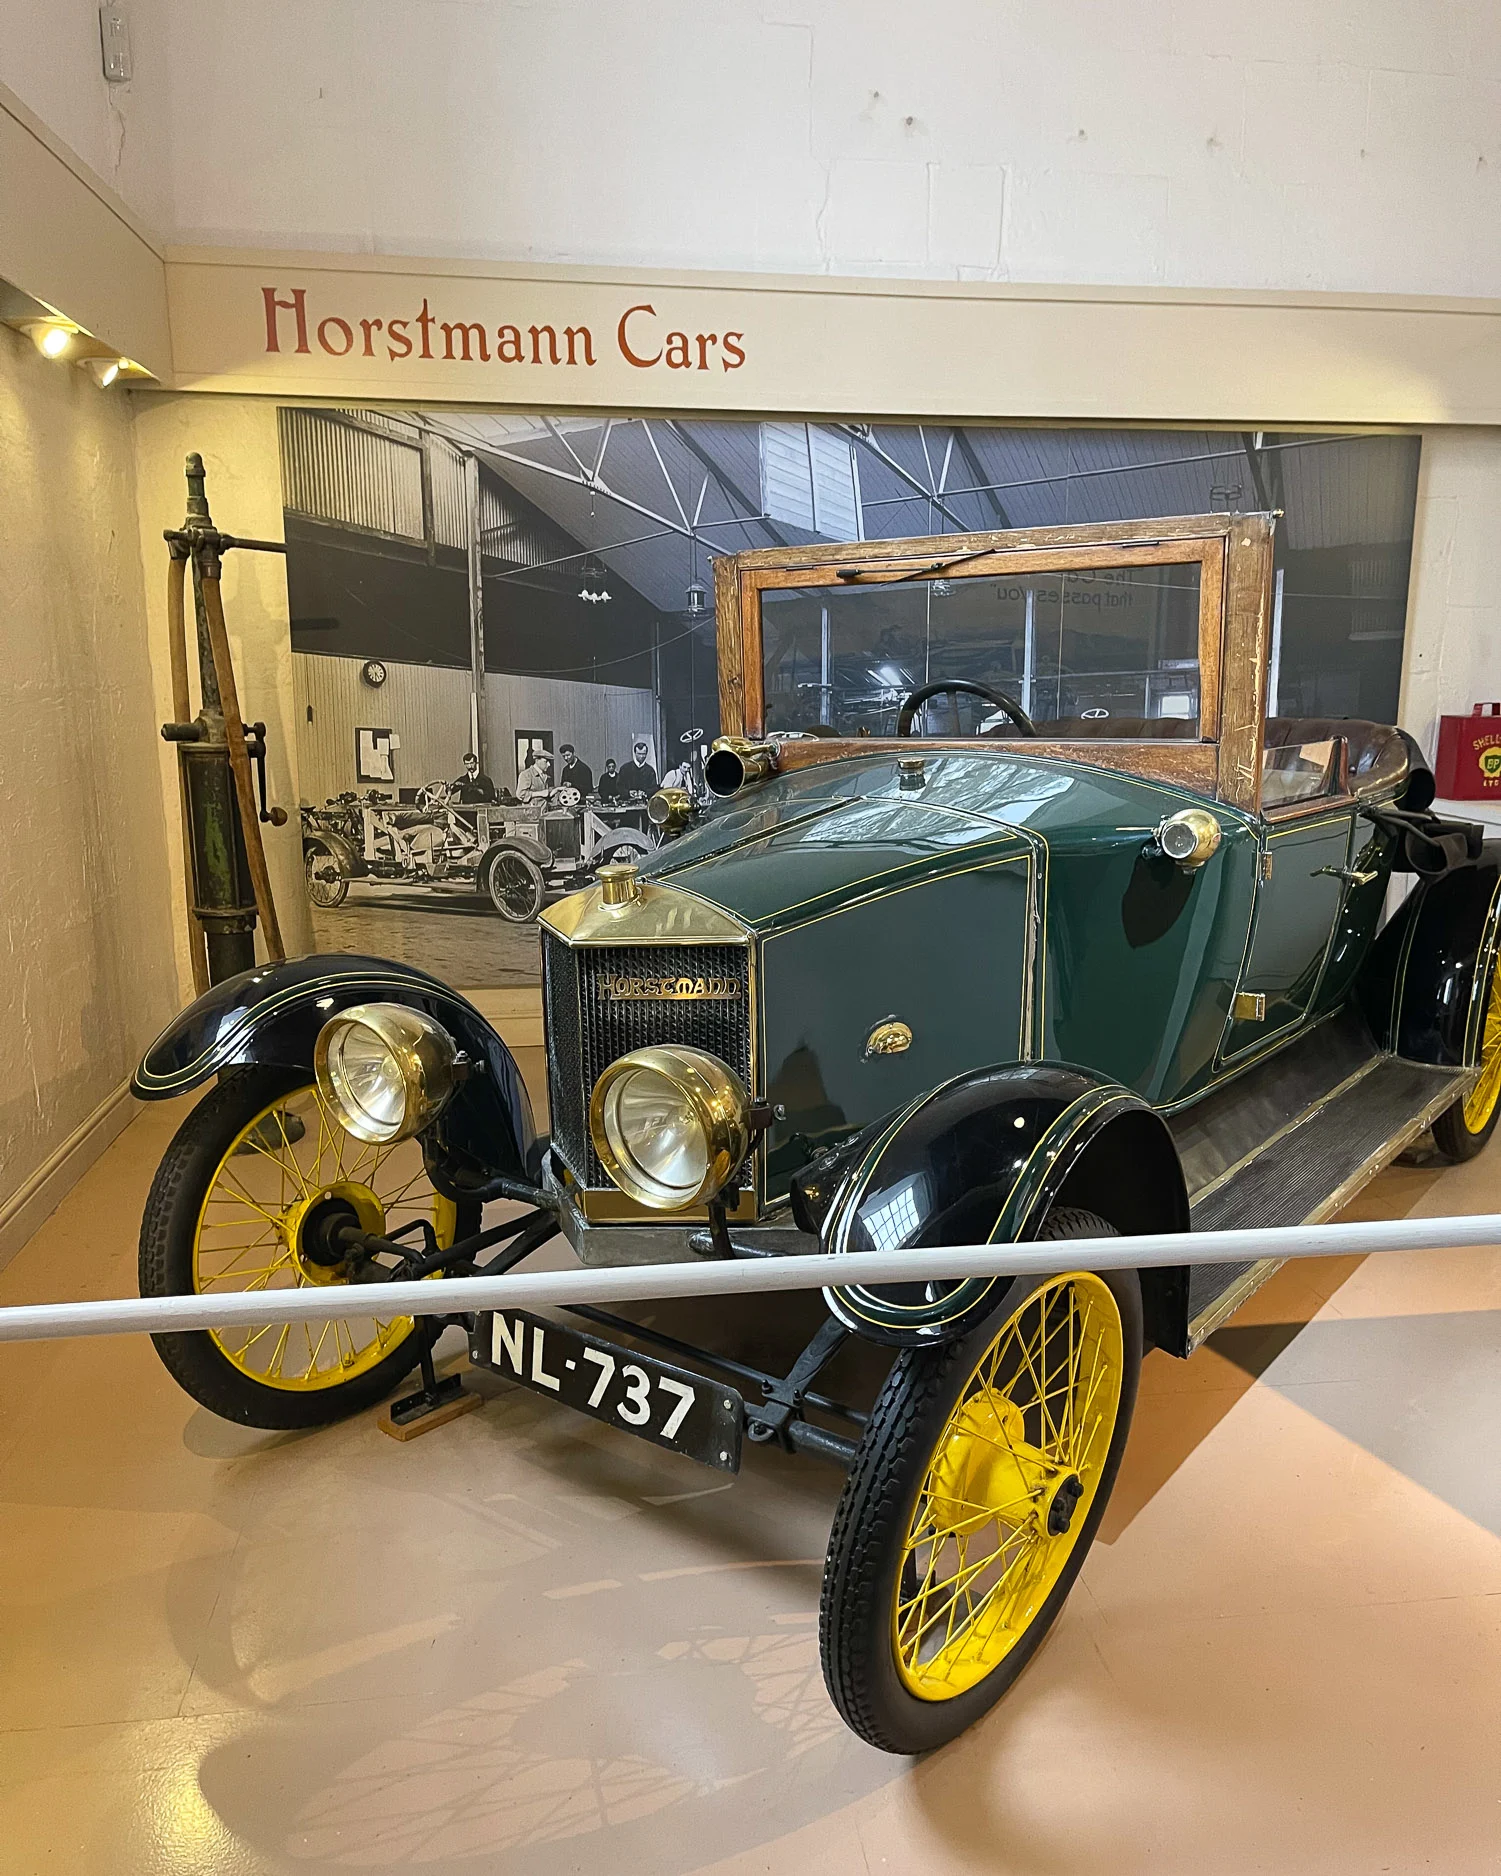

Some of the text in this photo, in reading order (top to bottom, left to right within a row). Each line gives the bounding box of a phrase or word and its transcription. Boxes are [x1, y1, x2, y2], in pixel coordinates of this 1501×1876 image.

[261, 286, 747, 373] Horstmann Cars
[1487, 758, 1499, 769] BP
